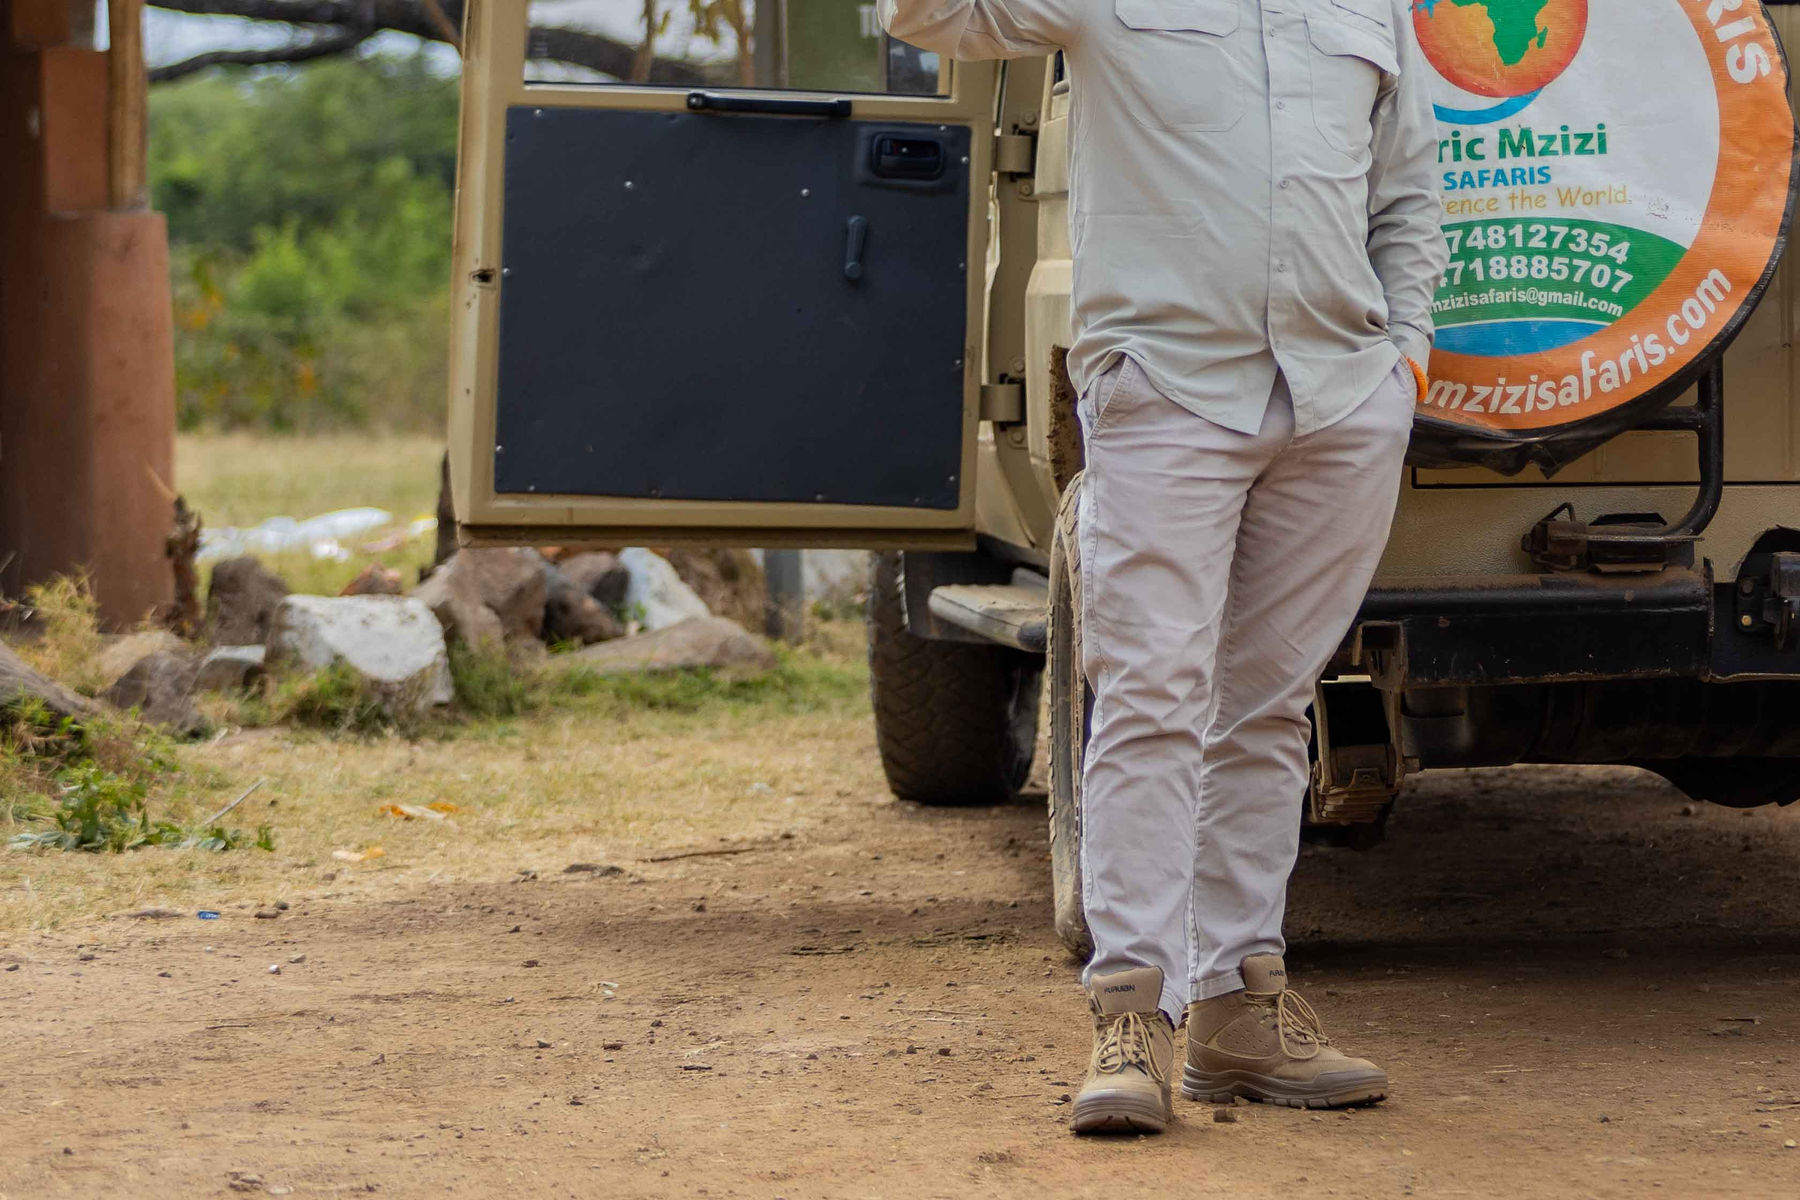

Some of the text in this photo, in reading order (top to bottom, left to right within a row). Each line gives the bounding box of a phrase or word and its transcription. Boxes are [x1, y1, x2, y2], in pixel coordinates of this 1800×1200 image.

[1437, 122, 1608, 163] ric Mzizi
[1442, 165, 1552, 191] SAFARIS
[1508, 189, 1547, 212] the
[1556, 184, 1628, 208] World
[1443, 223, 1631, 266] 748127354
[1439, 254, 1634, 295] 718885707
[1428, 286, 1624, 318] mzizisafaris@gmail.com
[1425, 266, 1733, 415] mzizisafaris.com
